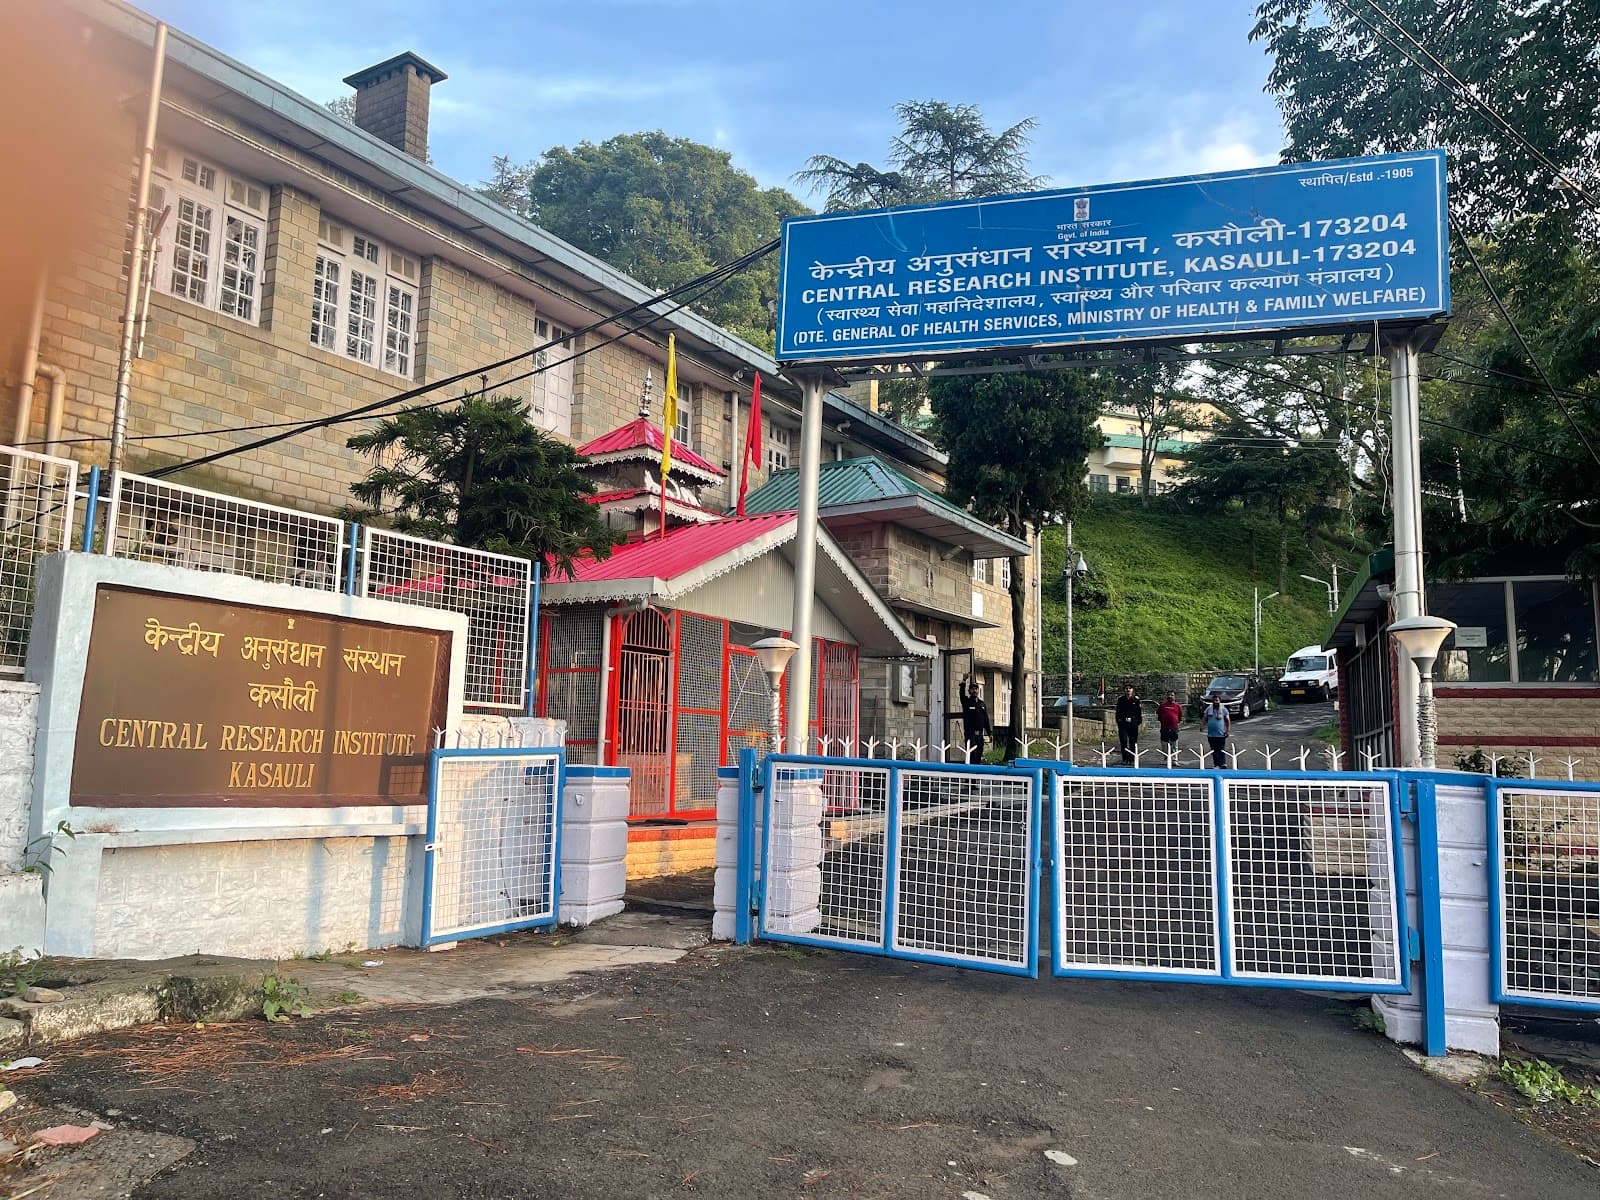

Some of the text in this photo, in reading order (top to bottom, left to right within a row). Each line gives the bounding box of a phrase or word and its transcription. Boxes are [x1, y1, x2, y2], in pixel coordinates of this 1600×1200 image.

[802, 239, 1416, 304] CENTRAL RESEARCH INSTITUTE, KASAULI-173204
[809, 256, 896, 281] केन्द्रीय
[907, 246, 1032, 277] अनुसंधान
[1172, 212, 1408, 249] कसौली-173204
[793, 286, 1426, 346] (DTE. GENERAL OF HEALTH SERVICES, MINISTRY OF HEALTH & FAMILY WELFARE)
[888, 302, 919, 317] सेवा
[1051, 287, 1113, 304] स्वास्थ्य
[1120, 283, 1153, 299] और
[1160, 279, 1222, 296] परिवार
[1229, 274, 1300, 291] कल्याण
[144, 618, 405, 677] केन्द्रीय अनुसंधान संस्थान
[247, 677, 319, 712] कसौली
[99, 718, 416, 756] CENTRAL RESEARCH INSTITUTE
[228, 761, 315, 789] KASAULI
